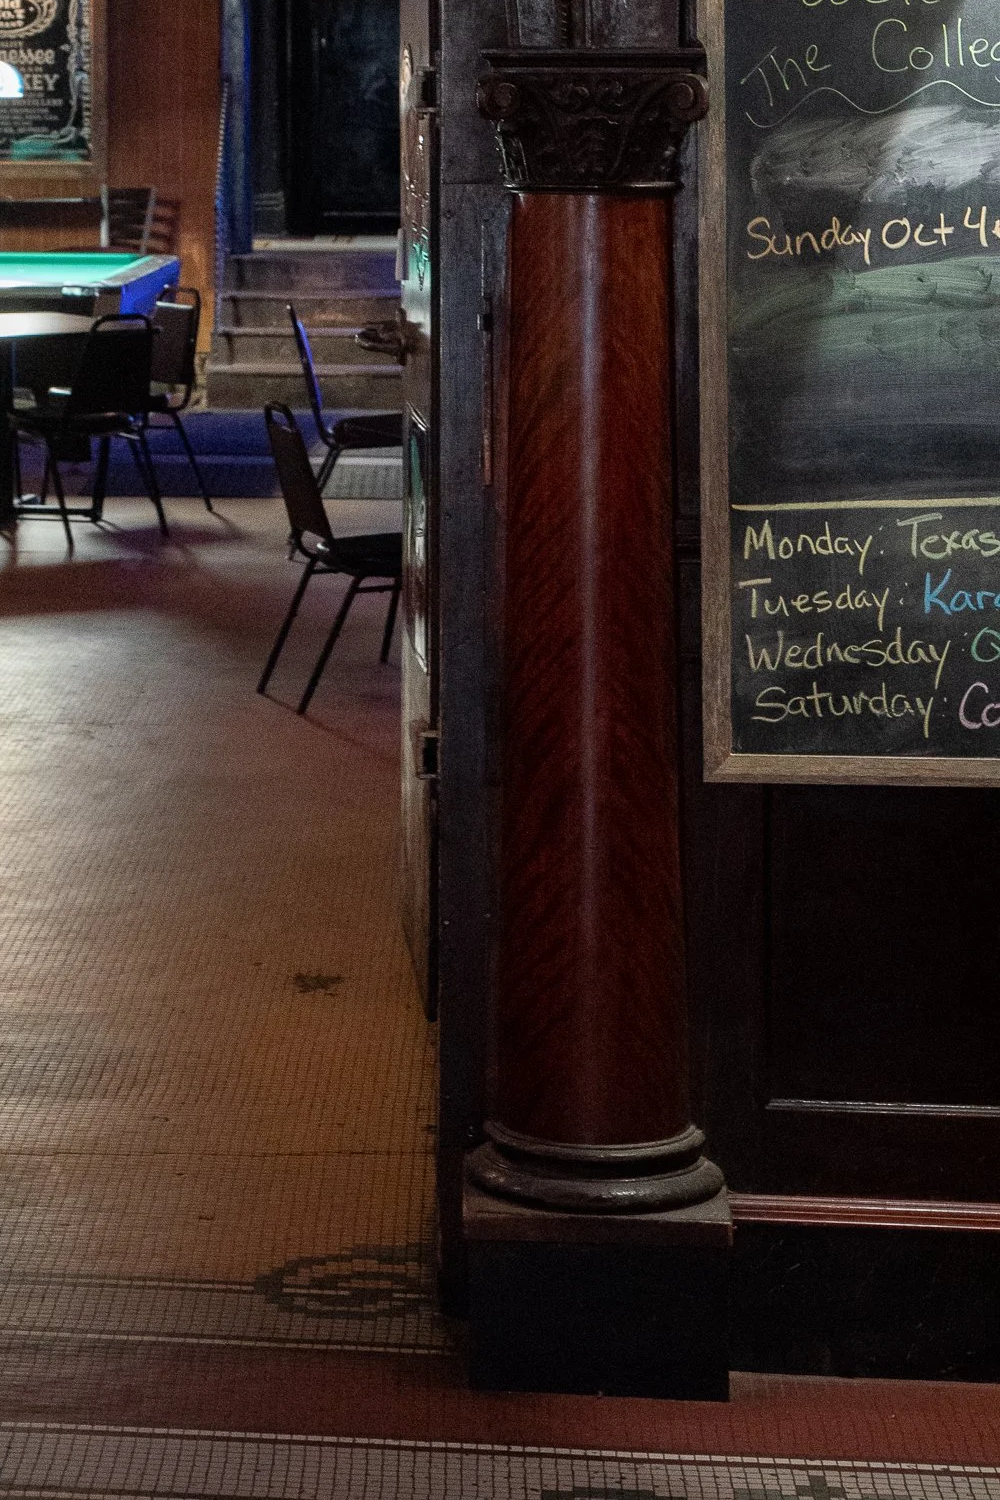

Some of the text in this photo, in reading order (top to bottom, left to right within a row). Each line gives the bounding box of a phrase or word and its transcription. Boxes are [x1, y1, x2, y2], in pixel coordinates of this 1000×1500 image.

[740, 44, 831, 107] The
[747, 206, 1000, 266] Sunday Oct 4
[897, 512, 1000, 560] Texas
